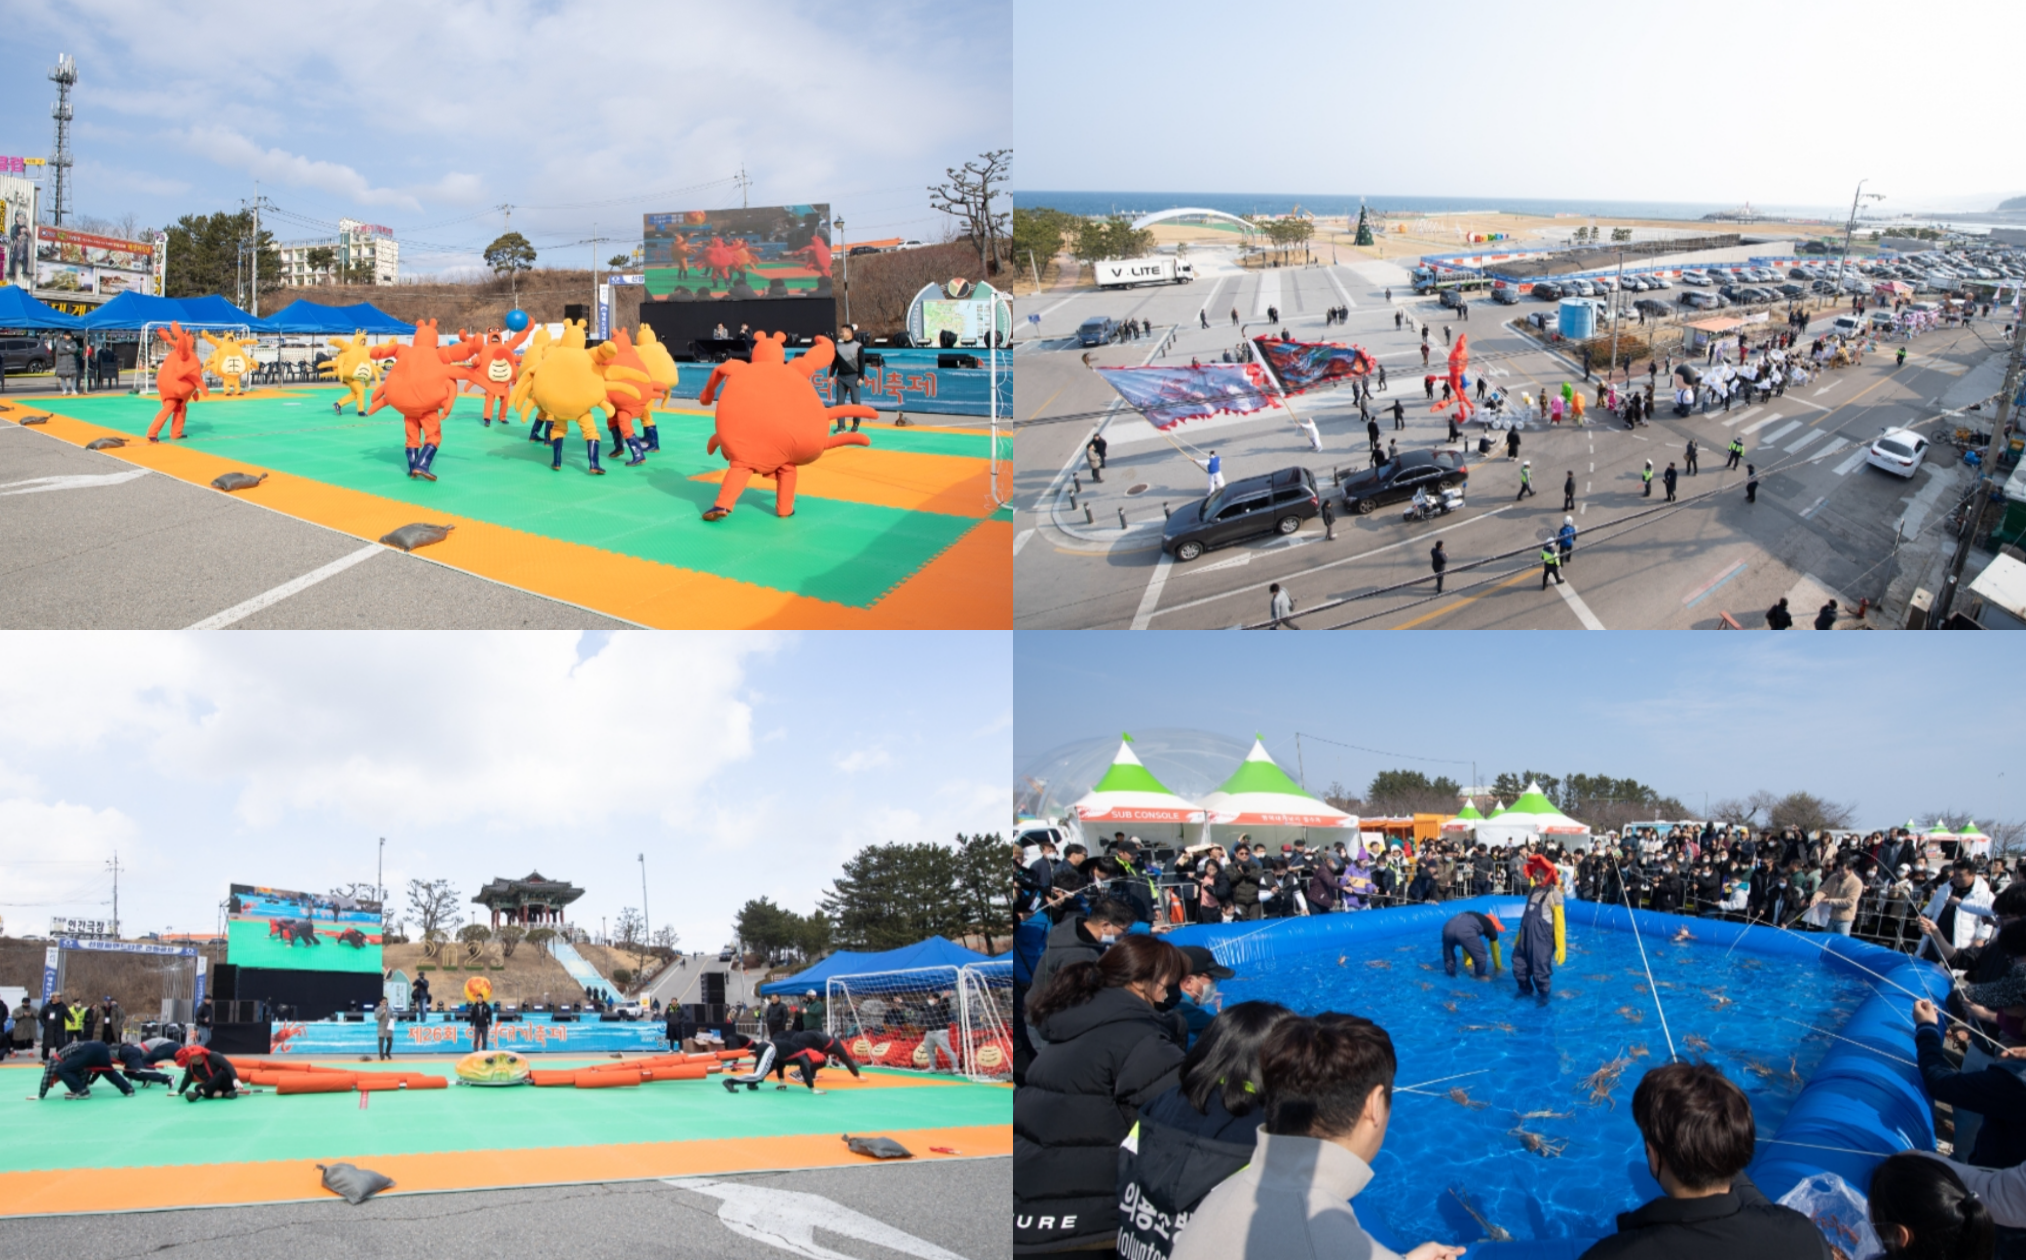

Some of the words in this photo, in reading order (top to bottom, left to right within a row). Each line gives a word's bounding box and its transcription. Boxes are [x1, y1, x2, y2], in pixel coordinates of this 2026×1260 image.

[1111, 810, 1131, 819] SUB
[1134, 810, 1179, 820] CONSOLE
[67, 919, 105, 934] 인간극장
[407, 1026, 457, 1044] 제26회
[1013, 1213, 1078, 1230] URE
